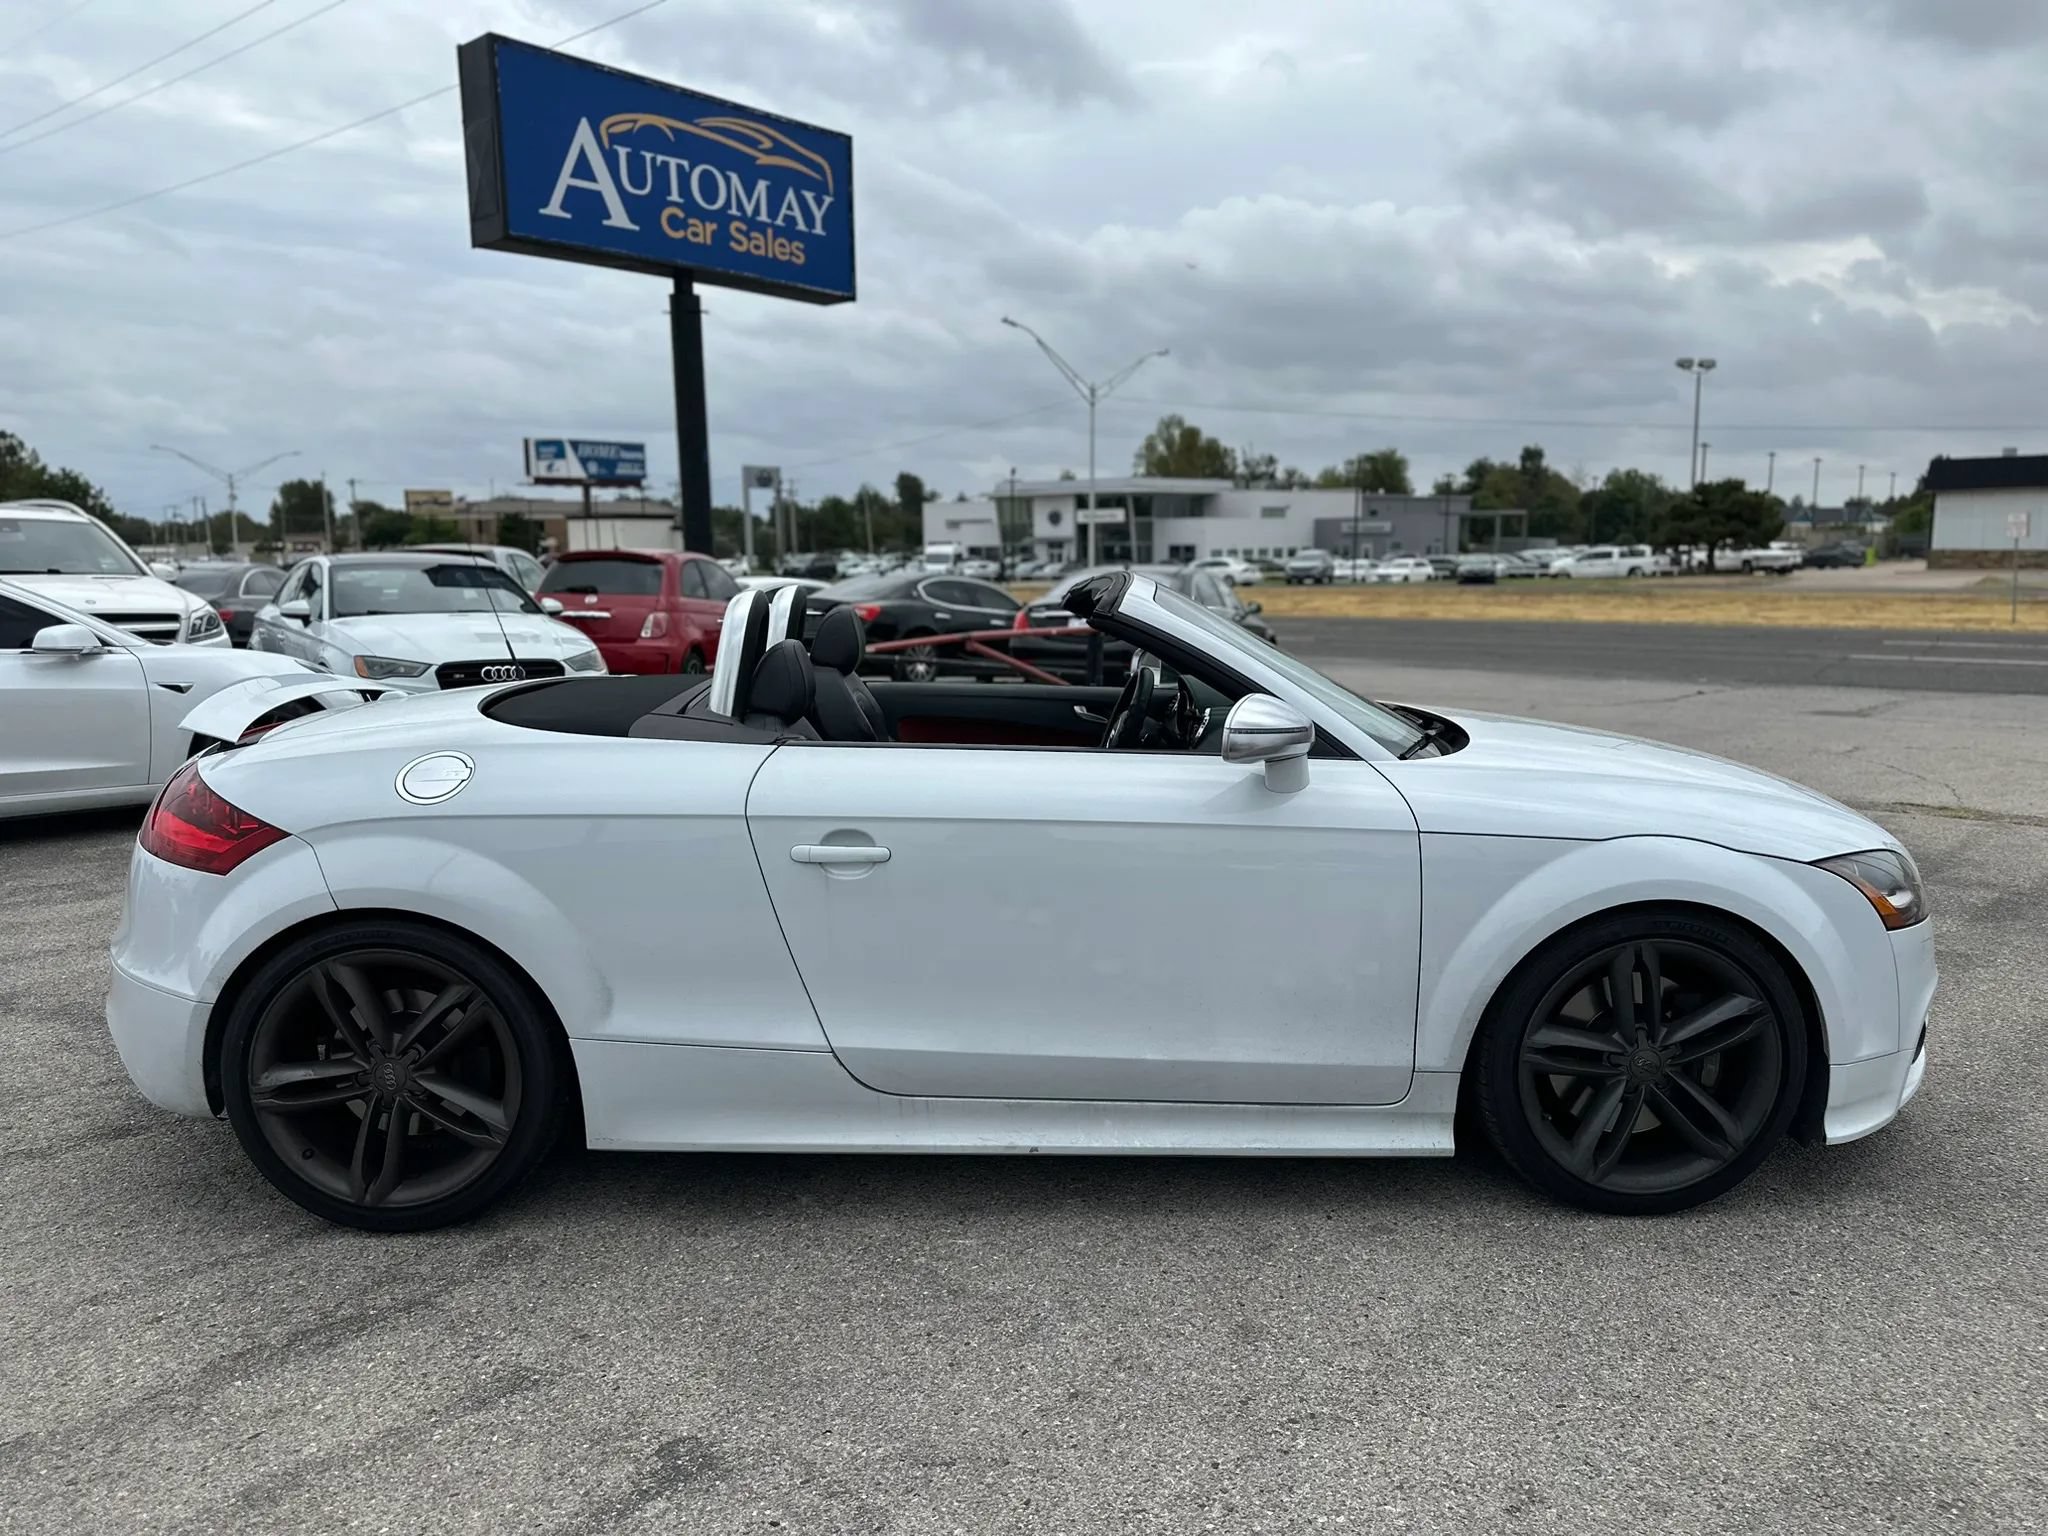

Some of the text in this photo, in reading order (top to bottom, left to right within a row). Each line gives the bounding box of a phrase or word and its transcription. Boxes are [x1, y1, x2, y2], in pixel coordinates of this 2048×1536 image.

[539, 116, 834, 236] AUTOMAY
[660, 206, 806, 265] Car Sales
